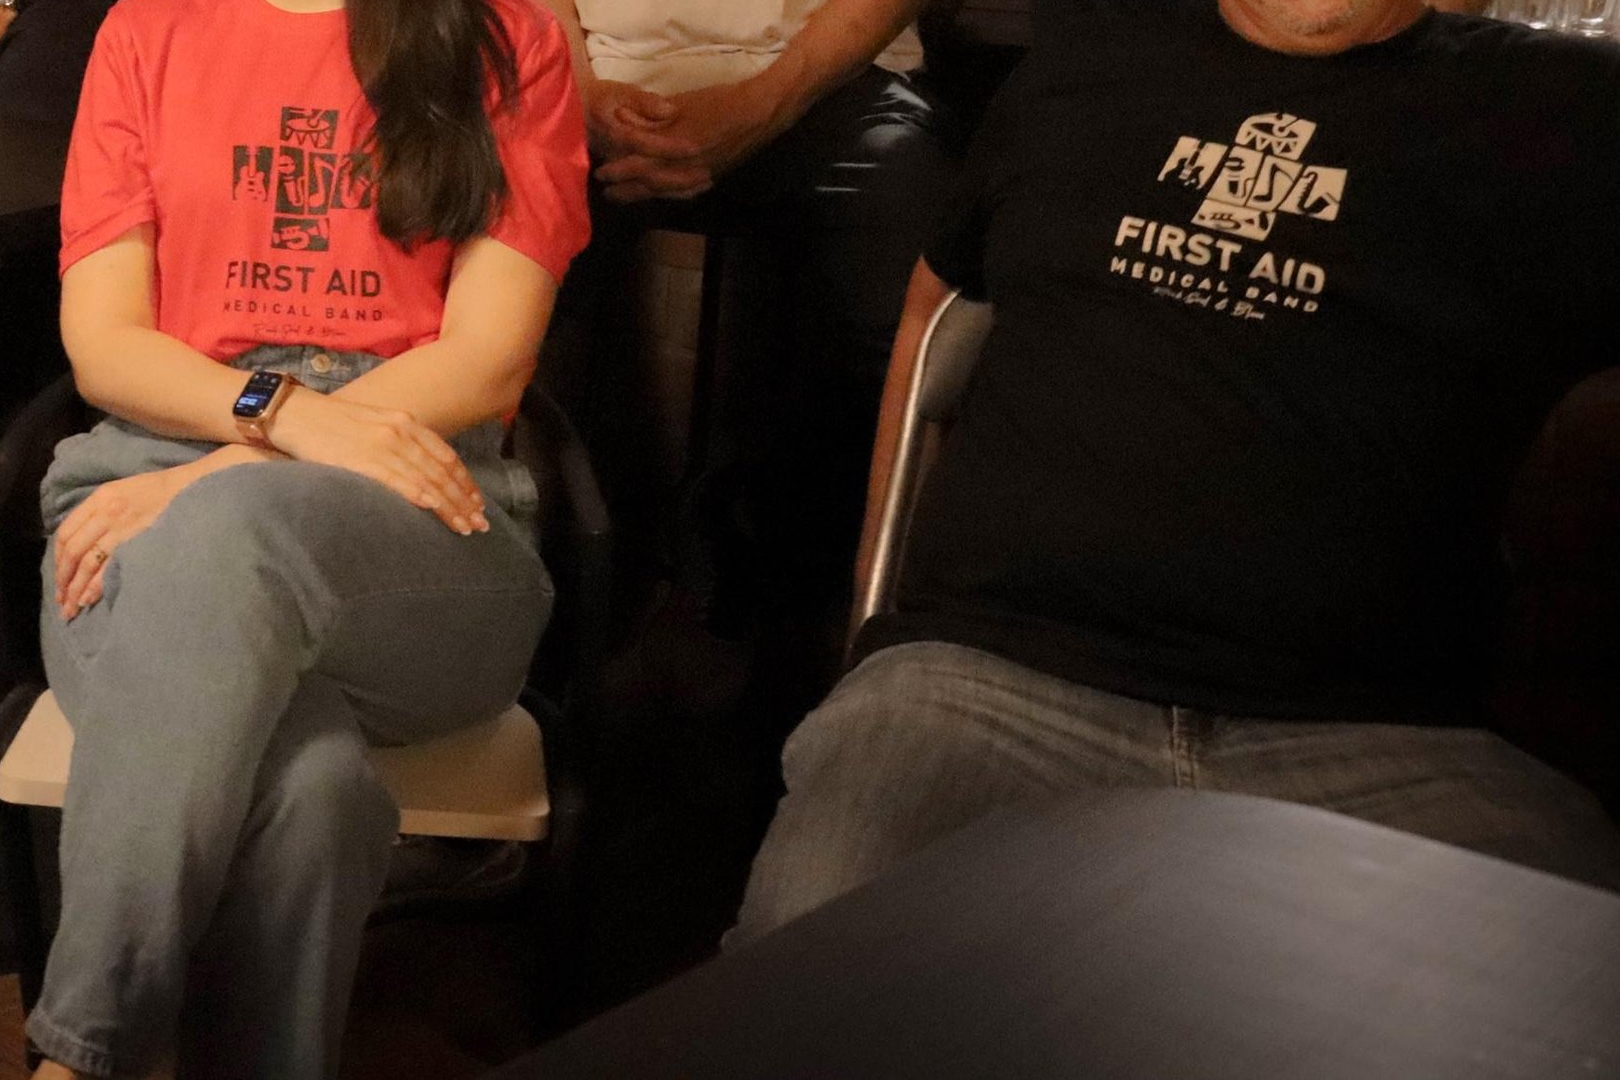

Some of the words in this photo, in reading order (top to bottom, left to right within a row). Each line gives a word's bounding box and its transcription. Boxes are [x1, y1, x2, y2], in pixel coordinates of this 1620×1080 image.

[1114, 215, 1242, 272] FIRST
[1249, 251, 1326, 295] AID
[225, 260, 316, 294] FIRST
[325, 268, 381, 298] AID
[1110, 256, 1229, 293] MEDICAL
[1245, 286, 1319, 312] BAND
[223, 300, 311, 318] MEDICAL
[325, 306, 385, 321] BAND
